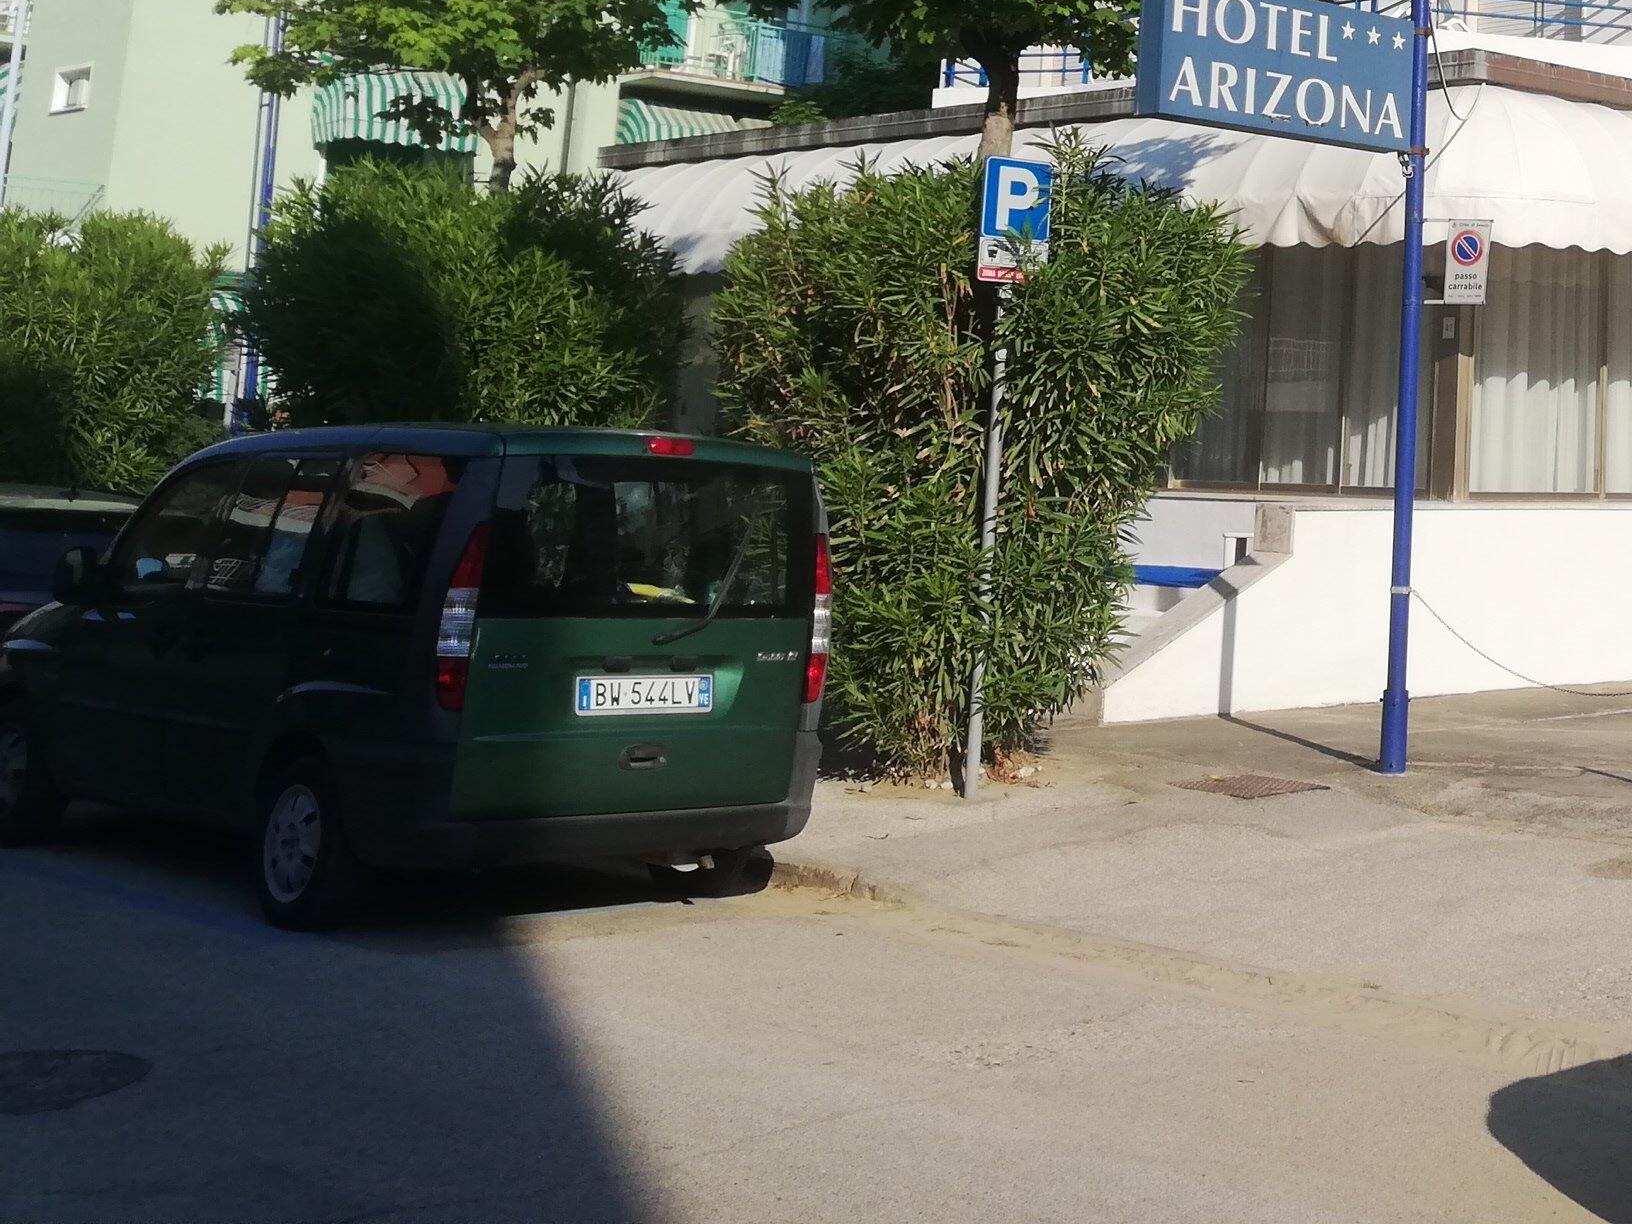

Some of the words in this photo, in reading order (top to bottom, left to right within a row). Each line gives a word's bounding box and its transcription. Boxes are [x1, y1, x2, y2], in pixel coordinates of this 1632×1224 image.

[1168, 55, 1404, 139] ARIZONA
[995, 165, 1040, 231] P
[1447, 282, 1483, 290] carrabile
[595, 682, 622, 707] BW
[630, 680, 696, 705] 544LV
[700, 693, 709, 705] VE
